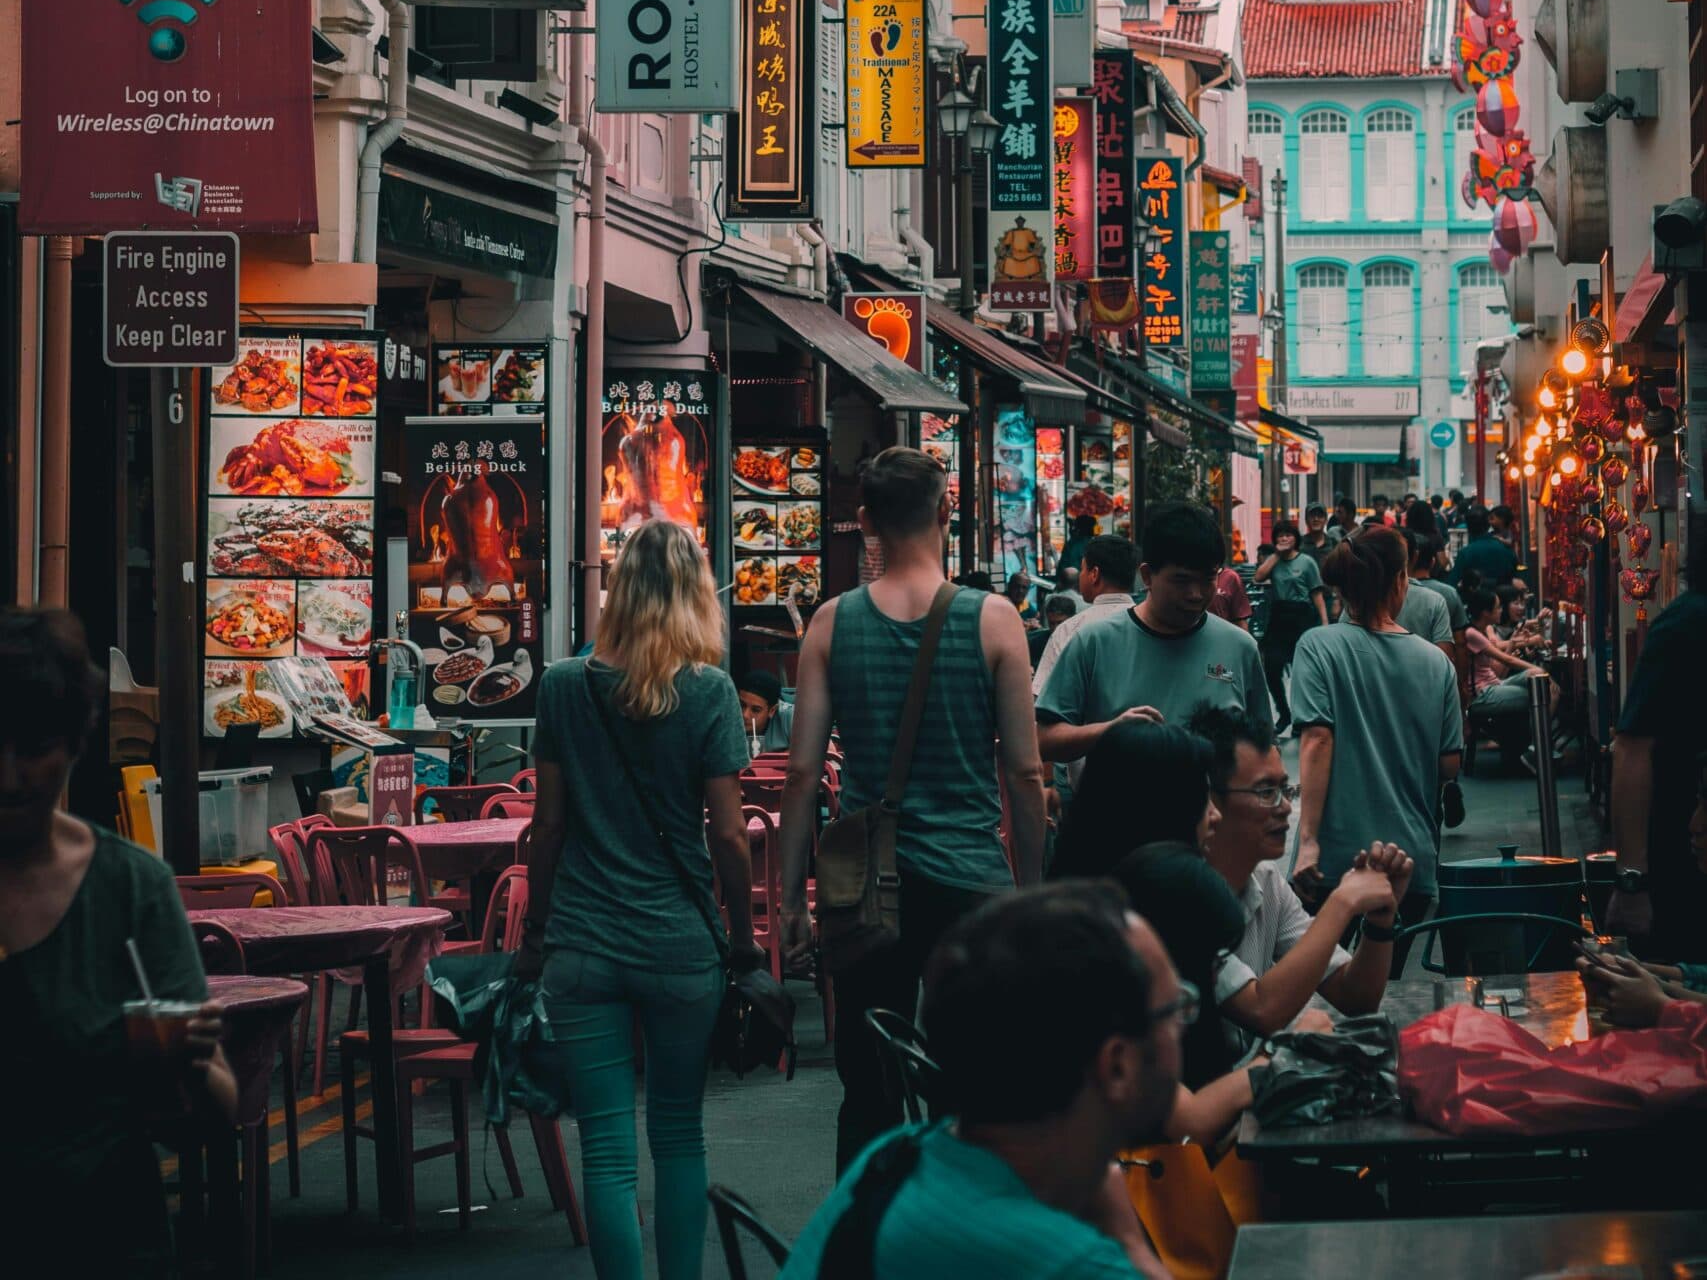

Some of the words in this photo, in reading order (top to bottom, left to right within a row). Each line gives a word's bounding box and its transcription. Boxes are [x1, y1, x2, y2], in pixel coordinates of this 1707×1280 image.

[873, 5, 897, 17] 22A
[684, 12, 699, 89] HOSTEL
[863, 58, 910, 67] Traditional
[125, 86, 159, 107] Log
[164, 89, 188, 103] on
[192, 87, 211, 103] to
[878, 67, 893, 143] MASSAGE
[57, 113, 275, 134] Wireless@Chinatown
[997, 163, 1043, 171] Manchurian
[90, 191, 130, 201] Supported
[131, 191, 143, 200] by:
[1010, 183, 1031, 192] TEL:
[116, 246, 154, 269] Fire
[162, 246, 226, 275] Engine
[135, 285, 208, 308] Access
[116, 324, 164, 353] Keep
[171, 324, 227, 347] Clear
[602, 401, 668, 416] Beijing
[675, 403, 710, 415] Duck
[425, 462, 482, 475] Beijing
[488, 461, 527, 472] Duck
